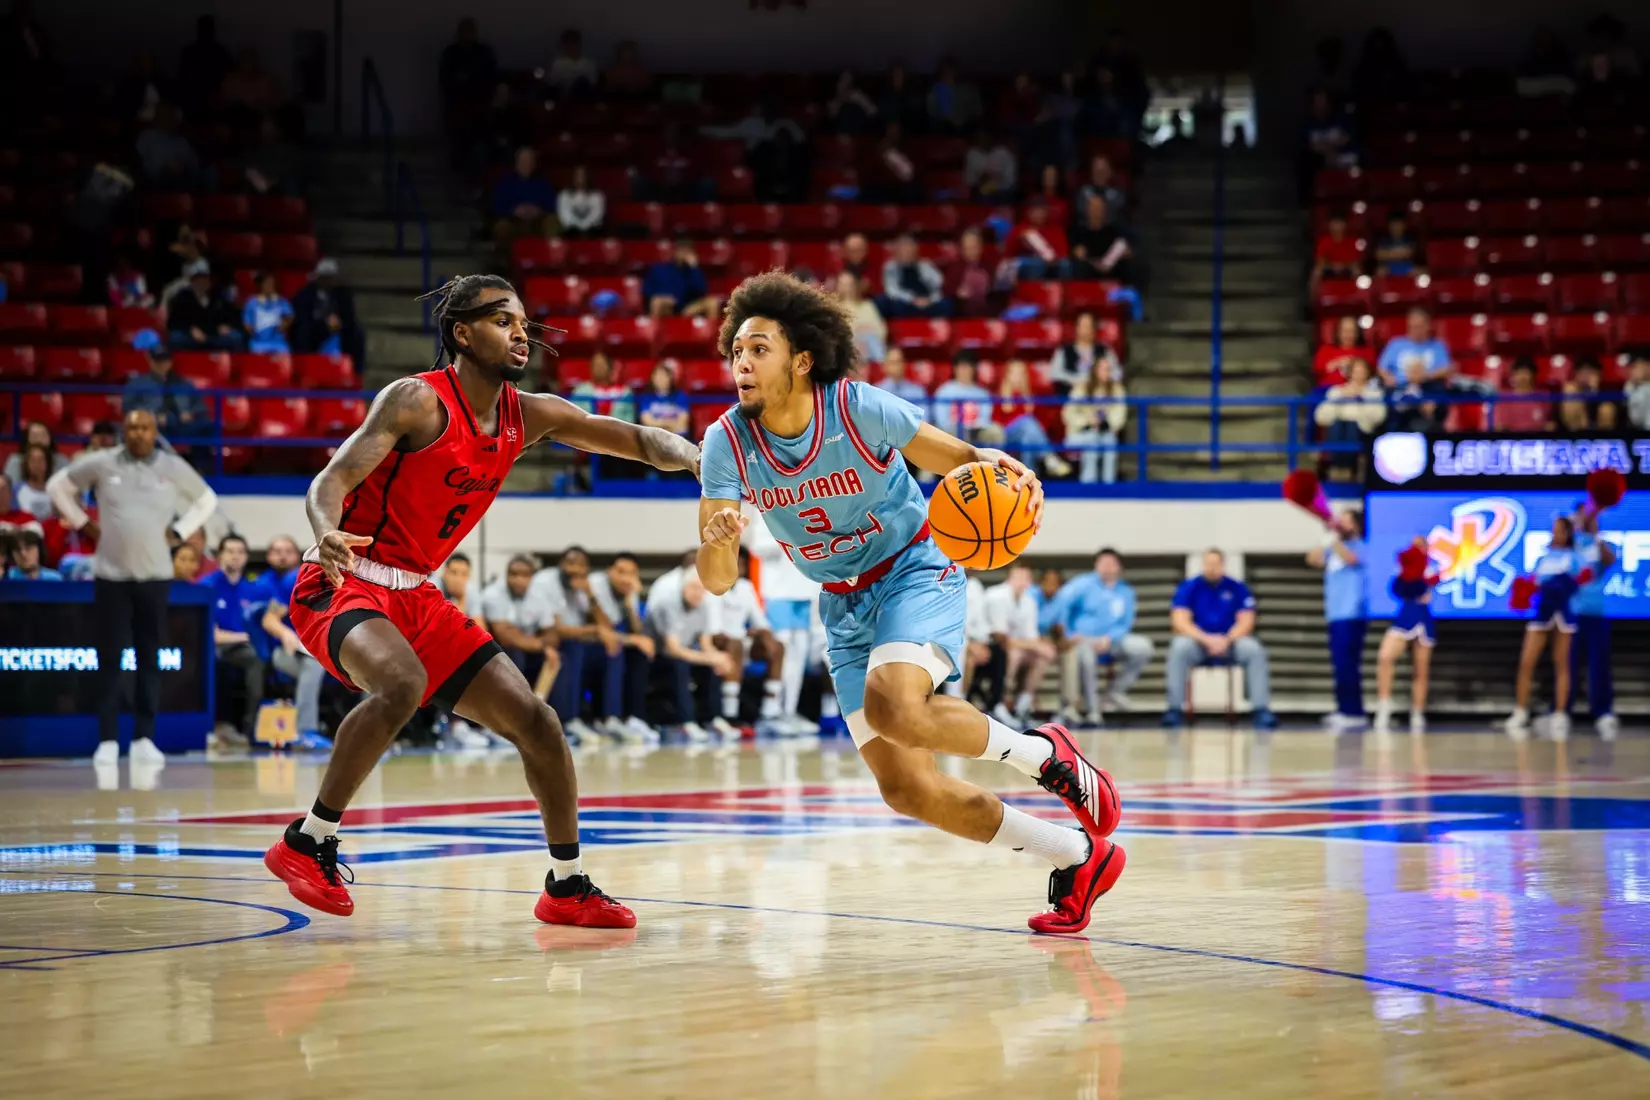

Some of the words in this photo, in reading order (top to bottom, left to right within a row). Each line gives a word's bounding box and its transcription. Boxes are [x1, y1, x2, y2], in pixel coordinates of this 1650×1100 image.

[751, 467, 865, 513] LOUISIANA
[438, 504, 470, 539] 6
[775, 511, 883, 564] TECH
[797, 506, 833, 535] 3
